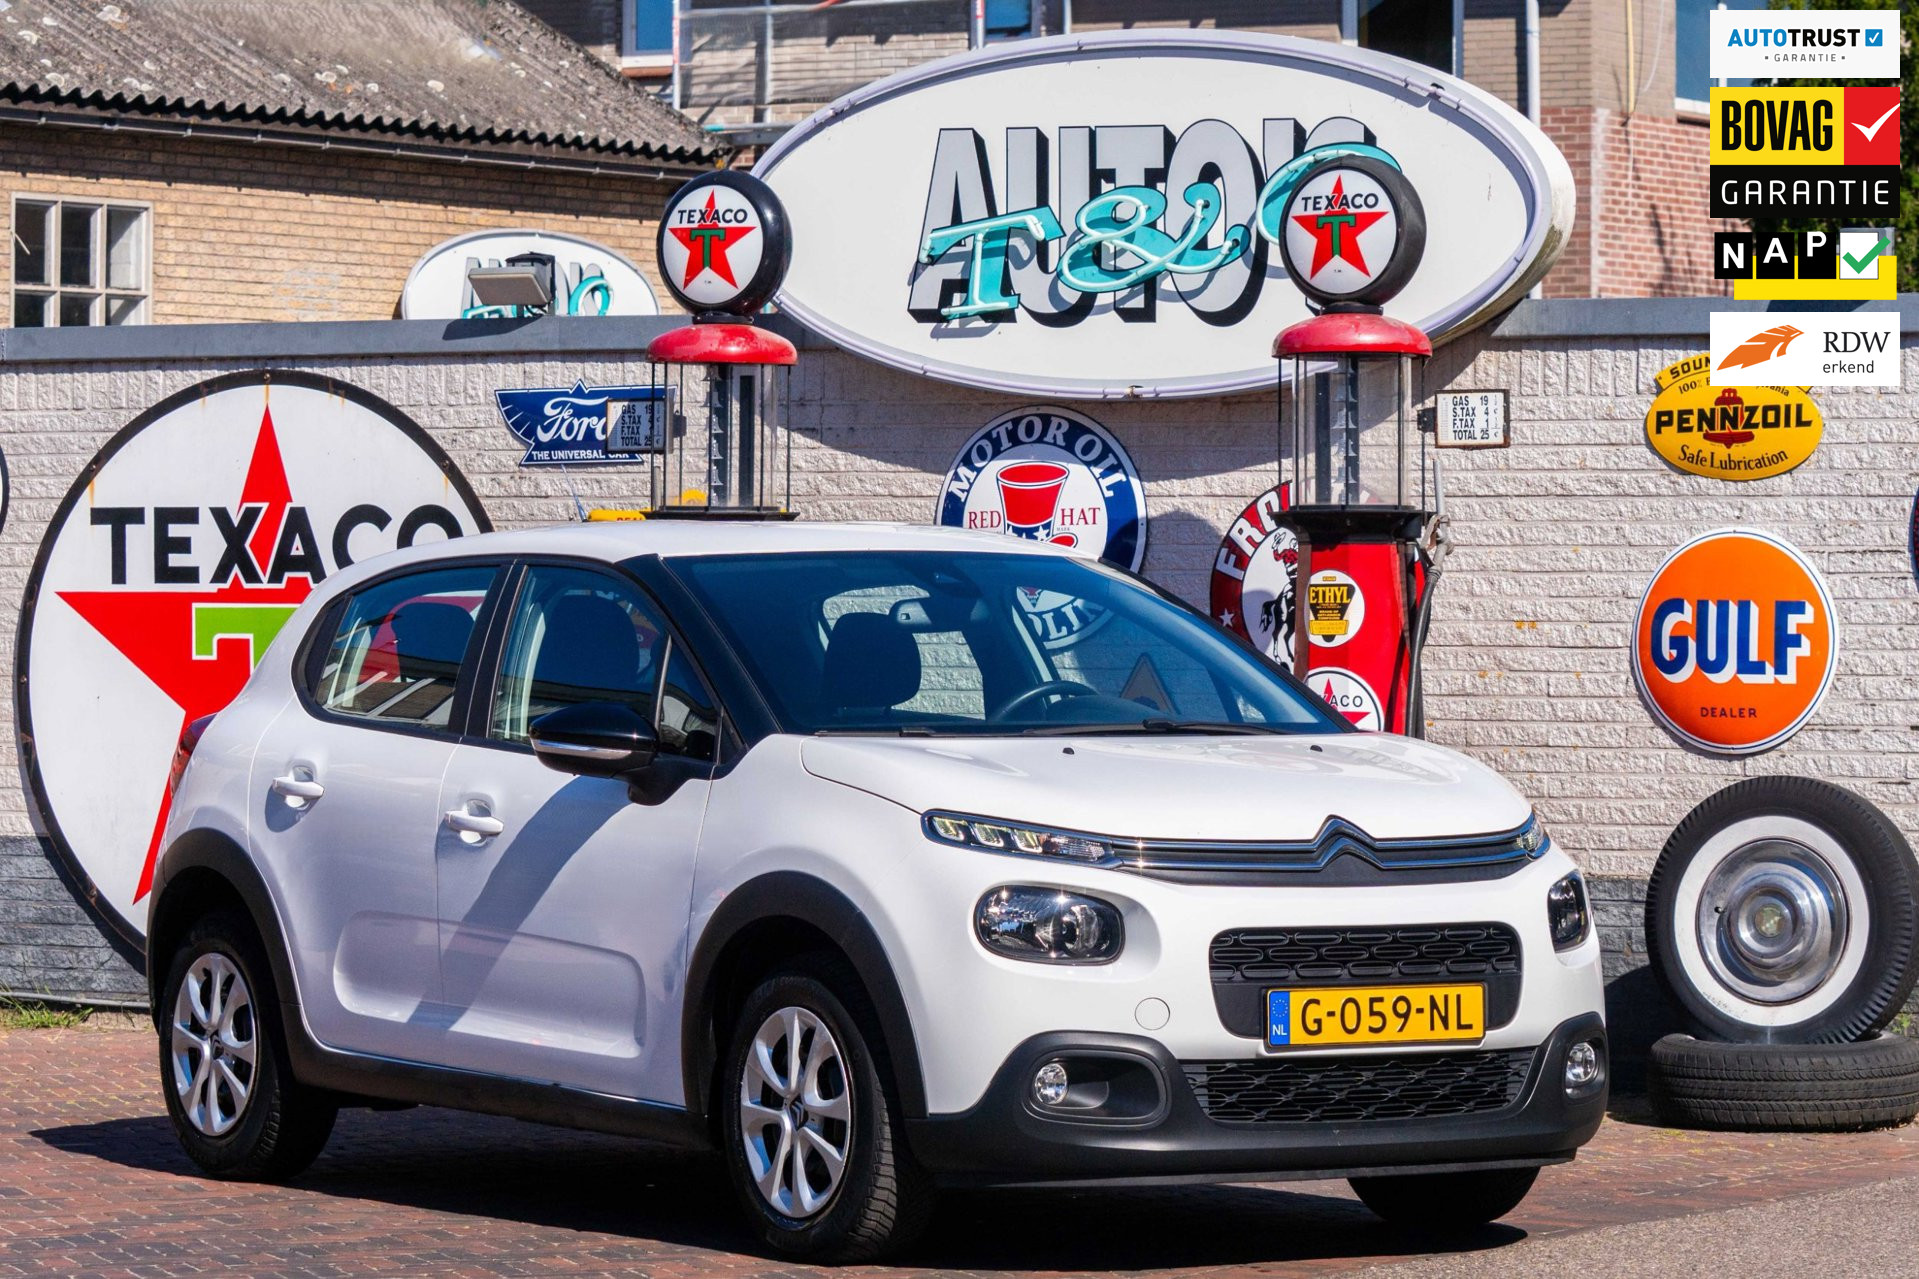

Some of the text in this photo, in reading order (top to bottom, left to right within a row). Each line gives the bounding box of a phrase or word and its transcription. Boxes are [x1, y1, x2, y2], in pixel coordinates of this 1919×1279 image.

[1301, 193, 1379, 212] TEXACO
[678, 208, 748, 224] TEXACO
[1452, 396, 1469, 406] GAS
[1480, 396, 1488, 406] 19
[622, 404, 636, 414] GAS
[1452, 407, 1476, 418] S.TAX
[1484, 407, 1489, 417] 4
[621, 415, 642, 426] S.TAX
[1453, 418, 1475, 428] F.TAX
[1655, 403, 1813, 435] PENNZOIL
[621, 426, 640, 436] F.TAX
[1453, 430, 1477, 440] TOTAL
[1480, 430, 1490, 440] 25
[621, 436, 642, 446] TOTAL
[531, 451, 550, 460] THE
[551, 450, 605, 460] UNIVERSAL
[948, 415, 1127, 502] MOTOR OIL
[1678, 444, 1789, 471] Safe Lubrication
[968, 507, 1100, 530] RED HAT
[1215, 483, 1293, 580] FRO
[1310, 586, 1350, 604] ETHYL
[1650, 597, 1815, 685] GULF
[1701, 707, 1757, 718] DEALER
[1301, 994, 1474, 1037] G-059-NL
[1272, 1025, 1287, 1036] NL
